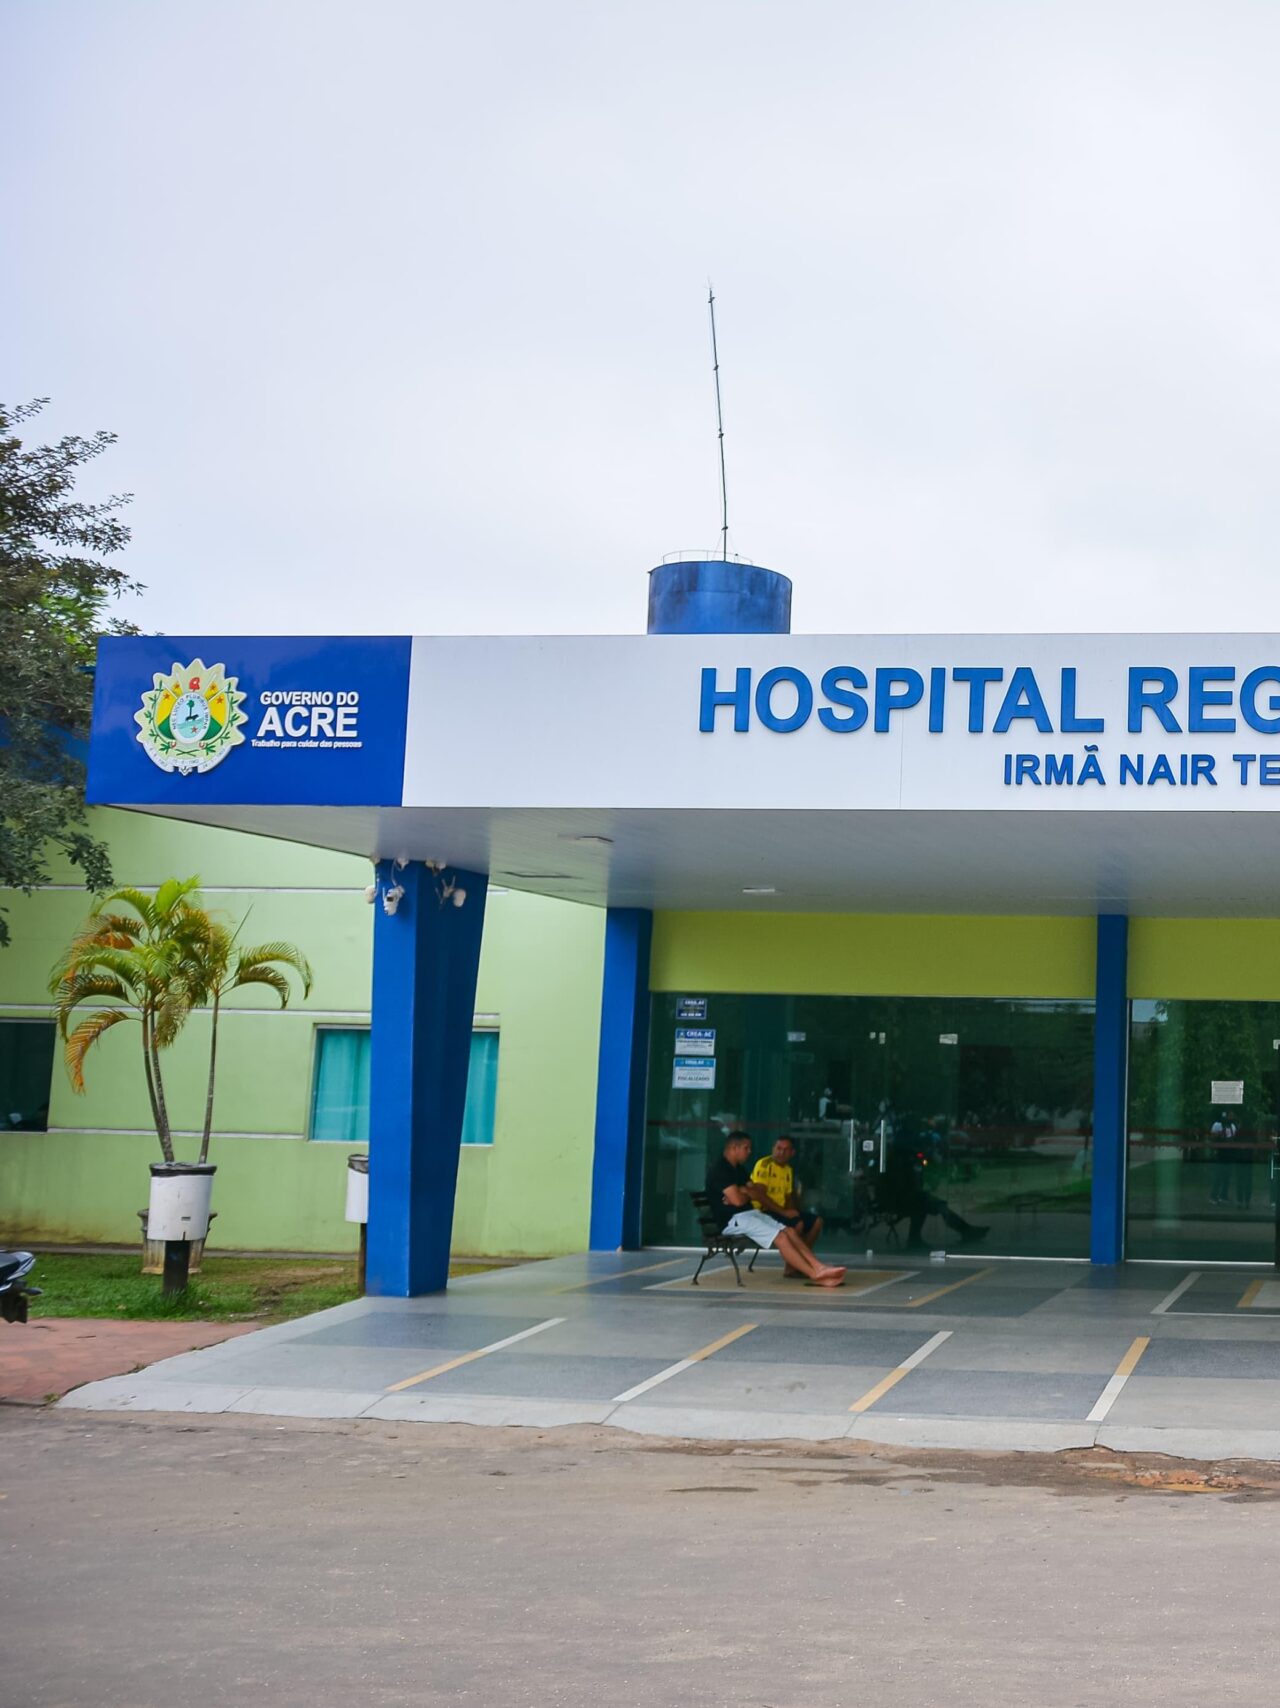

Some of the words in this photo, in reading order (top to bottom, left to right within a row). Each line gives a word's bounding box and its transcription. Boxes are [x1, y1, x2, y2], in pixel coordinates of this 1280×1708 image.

[259, 691, 334, 705] GOVERNO
[336, 691, 359, 706] DO
[699, 665, 1105, 734] HOSPITAL
[256, 705, 359, 738] ACRE
[251, 739, 281, 748] Trabalho
[281, 741, 298, 749] para
[298, 740, 319, 748] cuidar
[333, 741, 363, 749] pessoas
[1003, 744, 1107, 786] IRMÃ
[1119, 753, 1218, 786] NAIR
